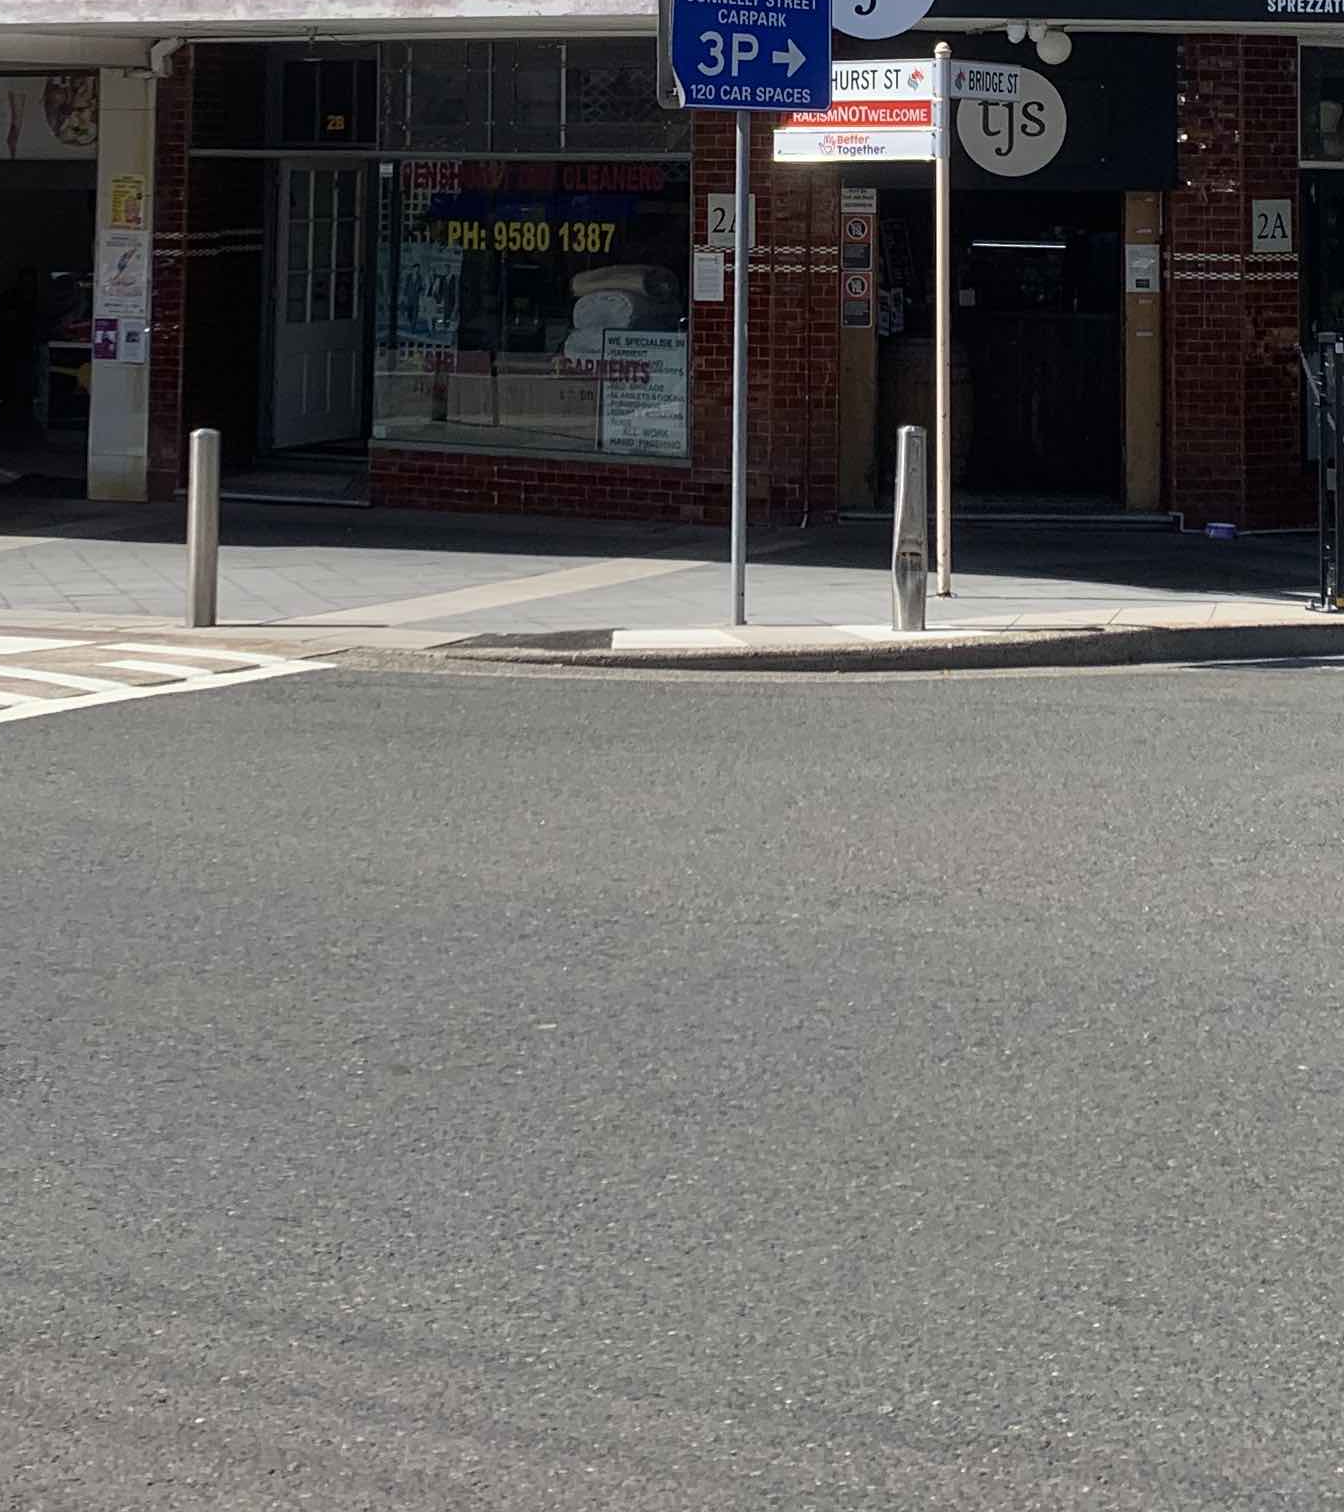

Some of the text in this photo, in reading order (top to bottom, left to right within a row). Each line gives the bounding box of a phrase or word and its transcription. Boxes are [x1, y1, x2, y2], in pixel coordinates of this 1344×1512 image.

[718, 9, 787, 27] CARPARK
[697, 31, 759, 77] 3P
[884, 69, 902, 91] ST
[969, 70, 1018, 94] BRIDGE ST
[690, 84, 811, 104] 120 CAR SPACES
[837, 135, 870, 144] Better
[447, 220, 616, 253] PH: 9580 1387
[1257, 213, 1288, 239] 2A
